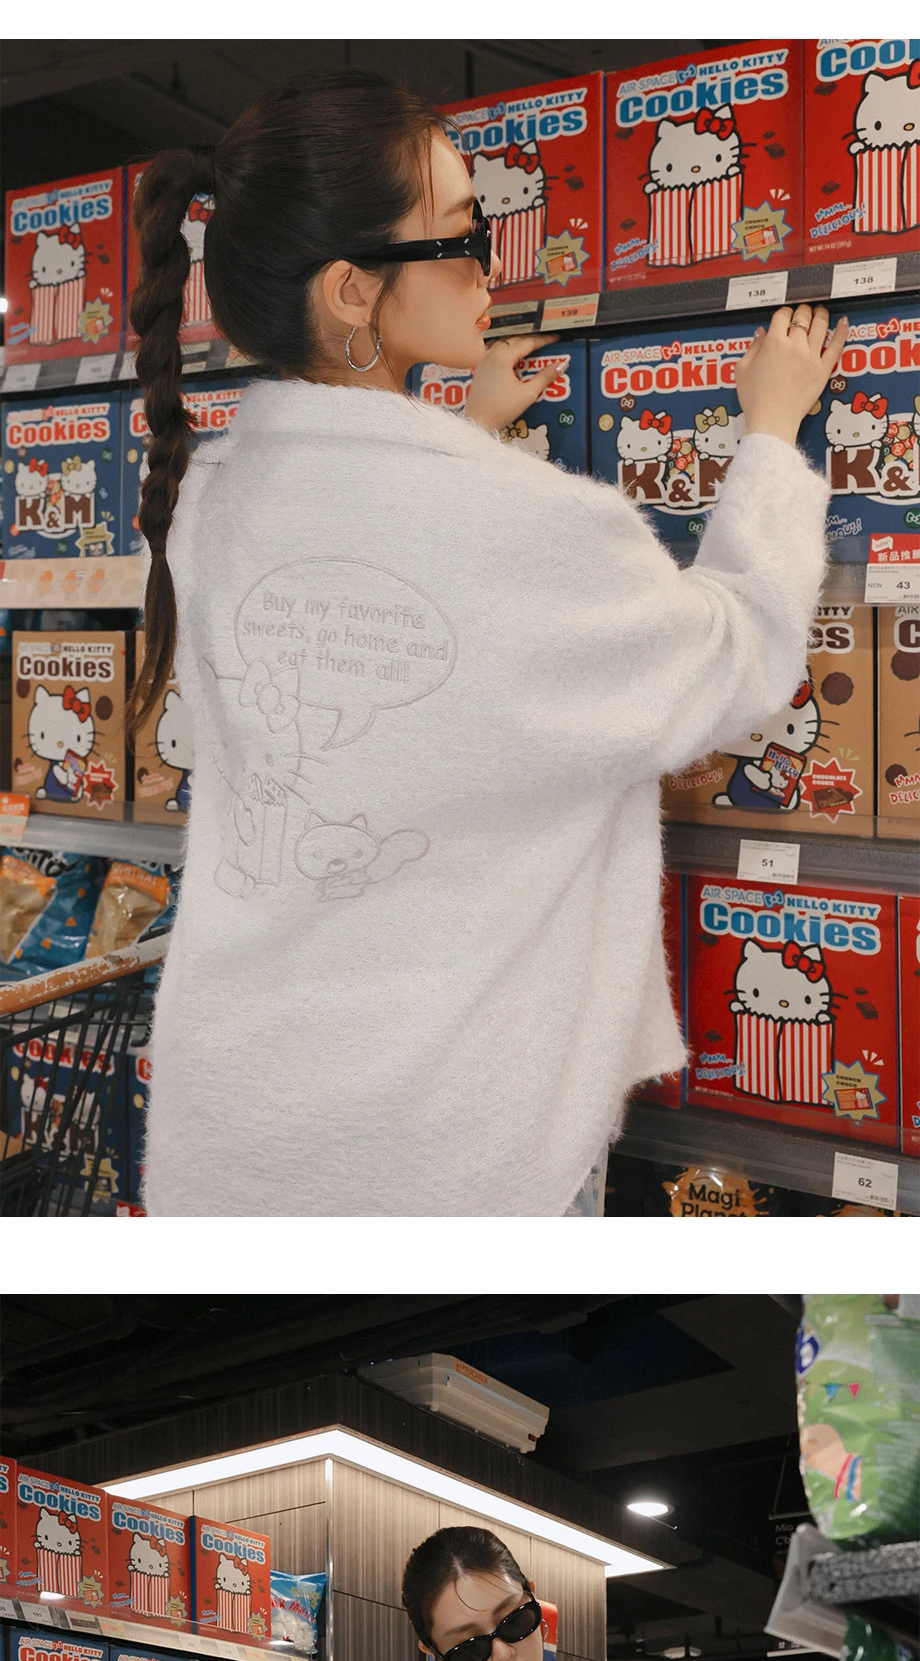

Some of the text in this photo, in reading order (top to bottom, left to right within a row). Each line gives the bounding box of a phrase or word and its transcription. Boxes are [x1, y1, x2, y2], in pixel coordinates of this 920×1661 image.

[618, 50, 787, 97] AIR SPACE HELLO KITTY
[618, 70, 787, 124] Cookies
[854, 274, 875, 286] 138
[748, 288, 767, 299] 138
[684, 341, 726, 355] HELLO
[8, 419, 108, 446] Cookies
[896, 581, 911, 590] 43
[20, 655, 112, 679] Cookies
[812, 773, 847, 782] CHOCOLATE
[761, 858, 775, 868] 51
[702, 888, 879, 917] AIR SPACE HELLO KITTY
[703, 902, 877, 952] Cookies
[688, 1182, 741, 1208] Magi
[858, 1176, 873, 1189] 62
[19, 1484, 101, 1521] Cookies
[112, 1511, 185, 1545] Cookies
